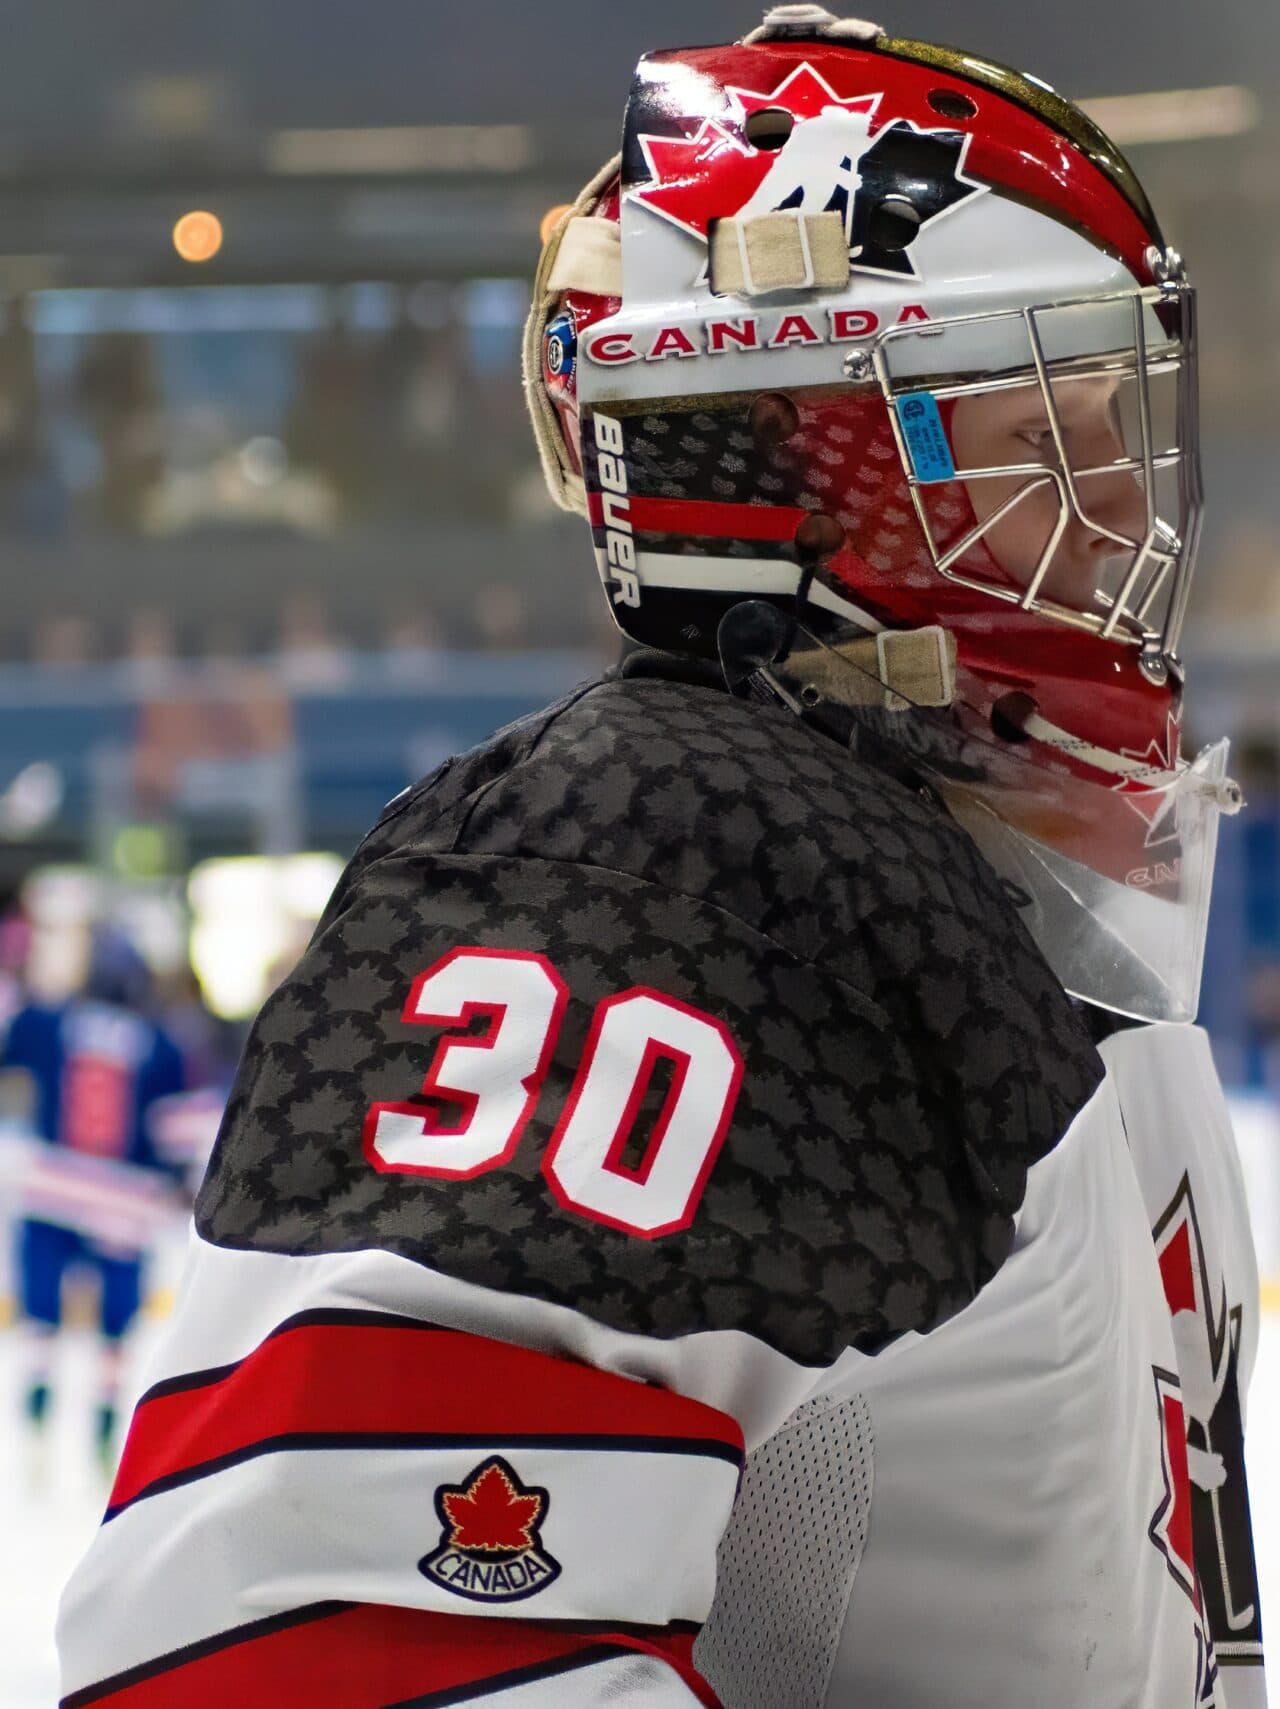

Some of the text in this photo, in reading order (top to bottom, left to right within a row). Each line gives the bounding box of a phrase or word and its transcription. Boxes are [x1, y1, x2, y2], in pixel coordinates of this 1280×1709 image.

[586, 303, 944, 366] CANADA
[362, 946, 745, 1240] 30
[436, 1553, 548, 1592] CANADA
